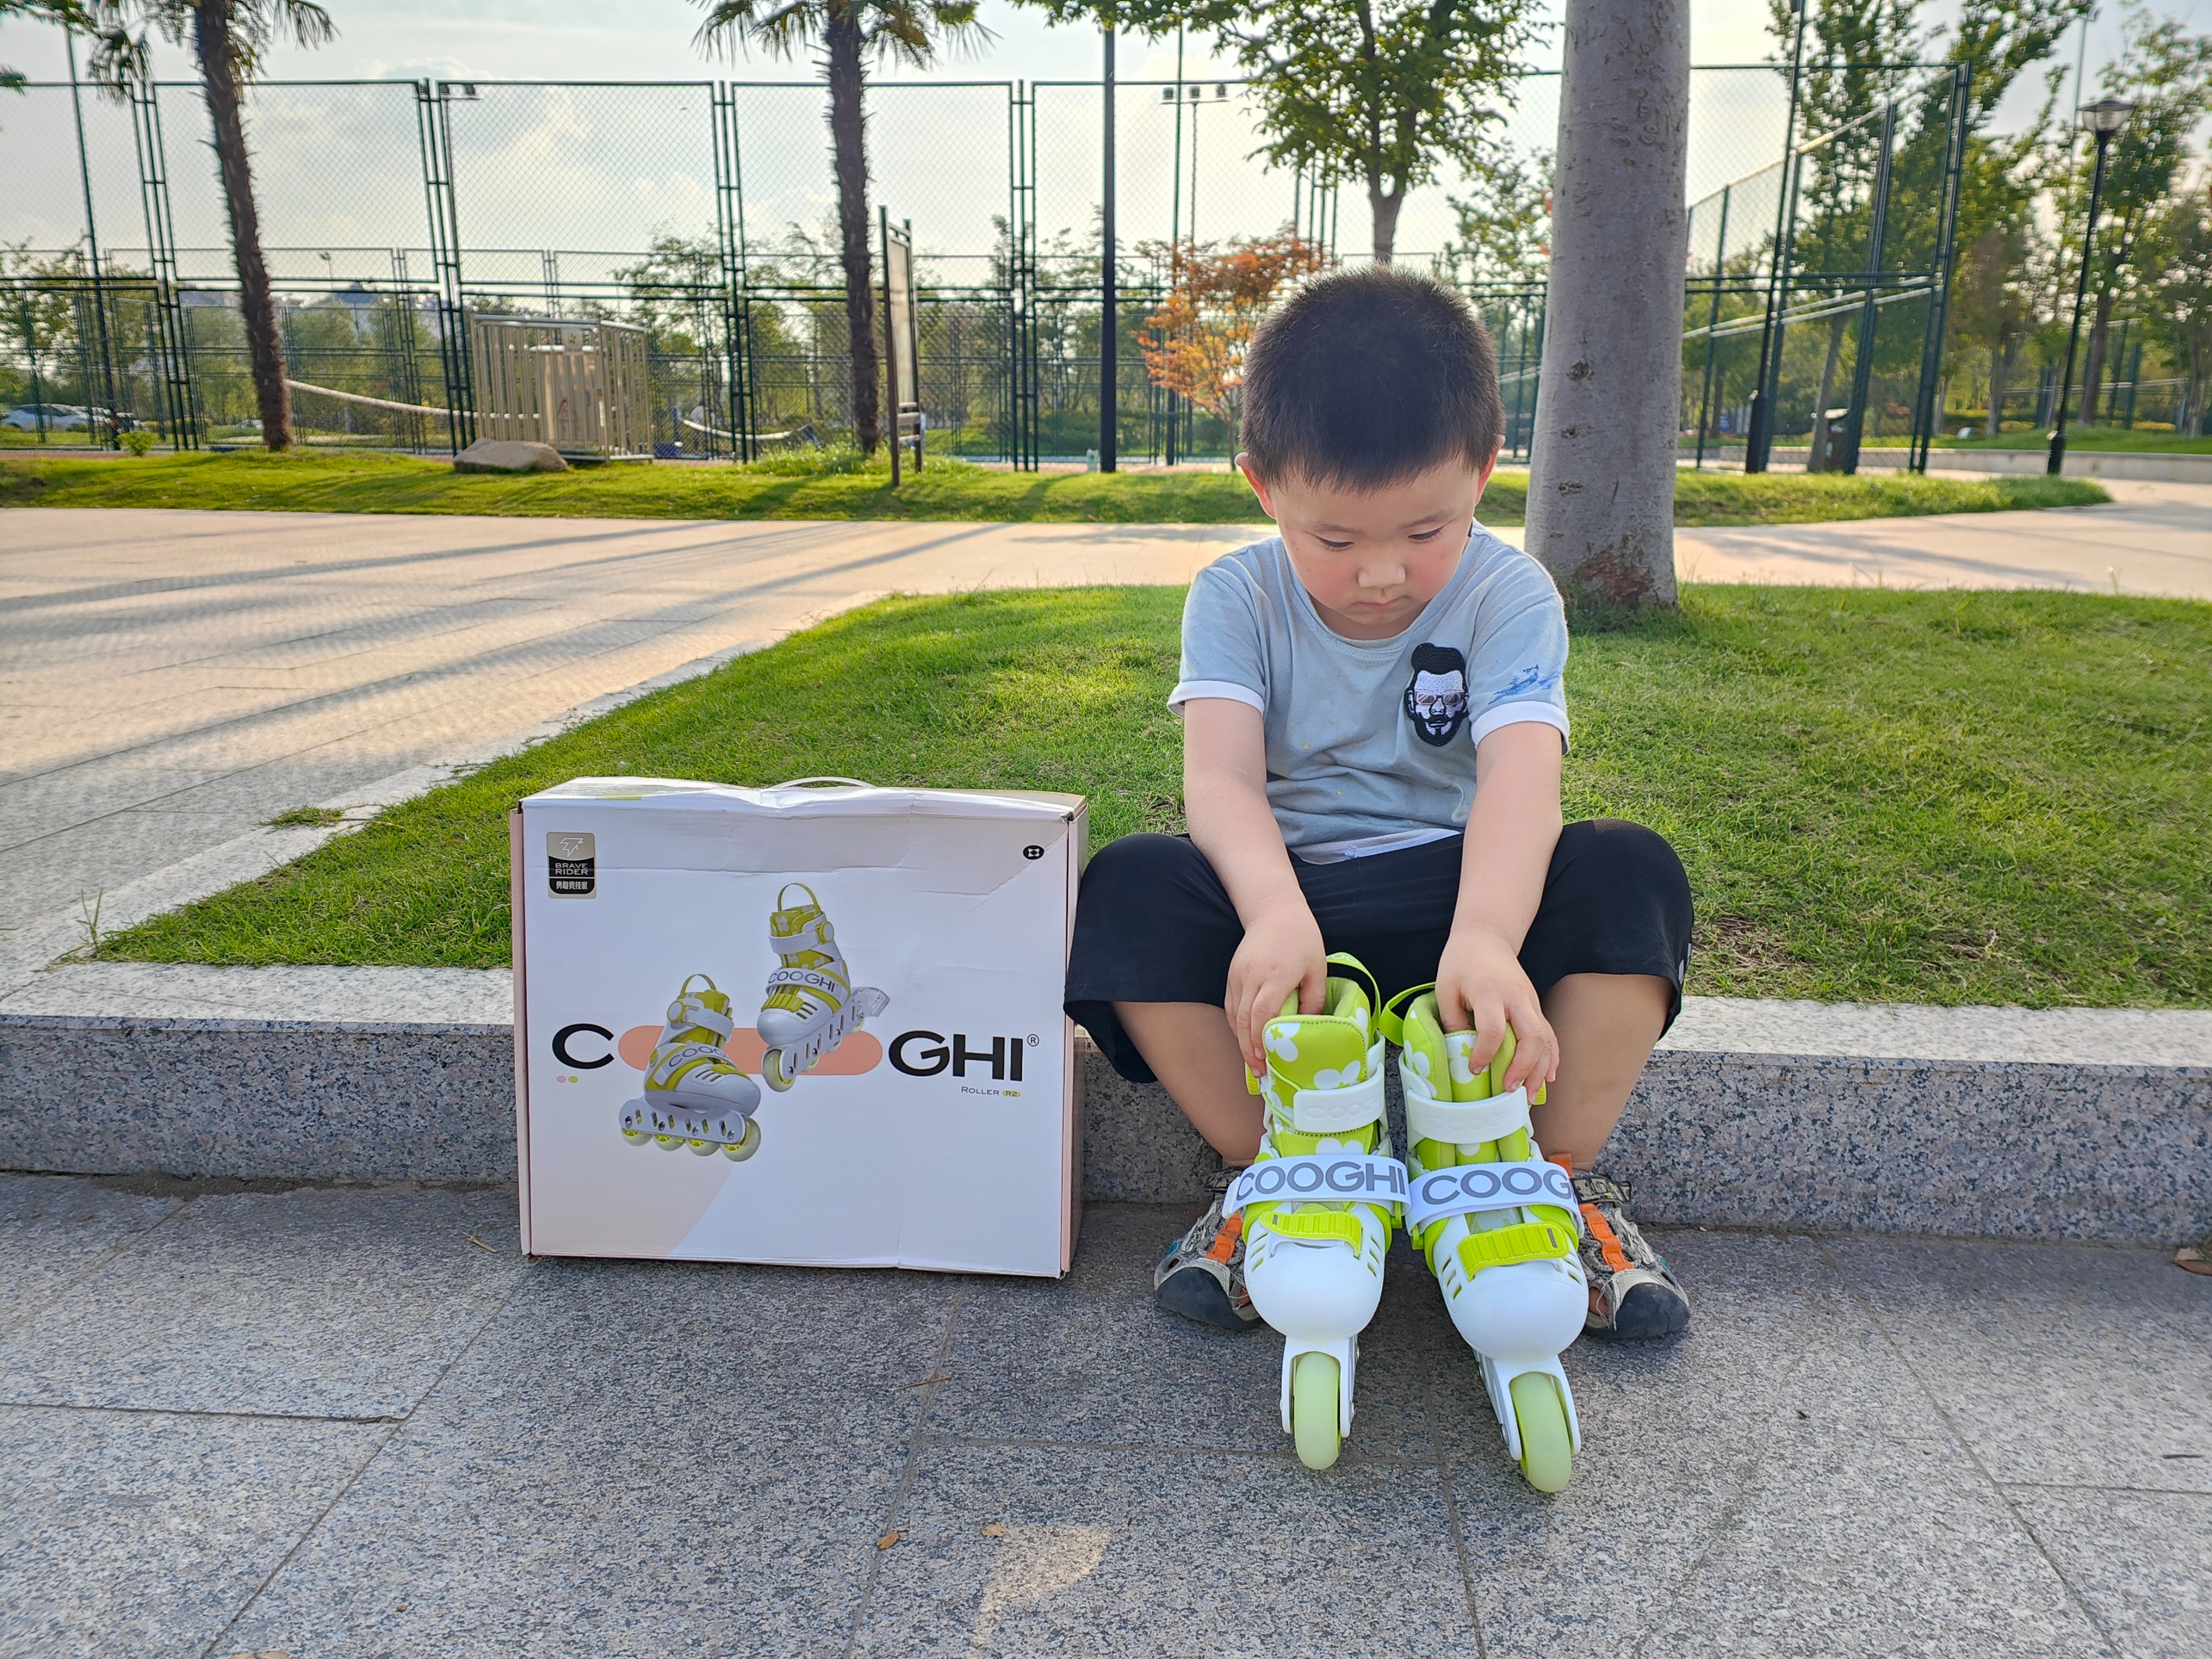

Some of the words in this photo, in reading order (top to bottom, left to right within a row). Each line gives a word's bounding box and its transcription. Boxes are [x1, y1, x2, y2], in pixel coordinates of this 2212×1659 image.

[768, 971, 835, 992] COOGHI
[669, 1046, 729, 1067] COOG
[1236, 1161, 1406, 1201] COOGHI
[1422, 1167, 1575, 1205] COOG
